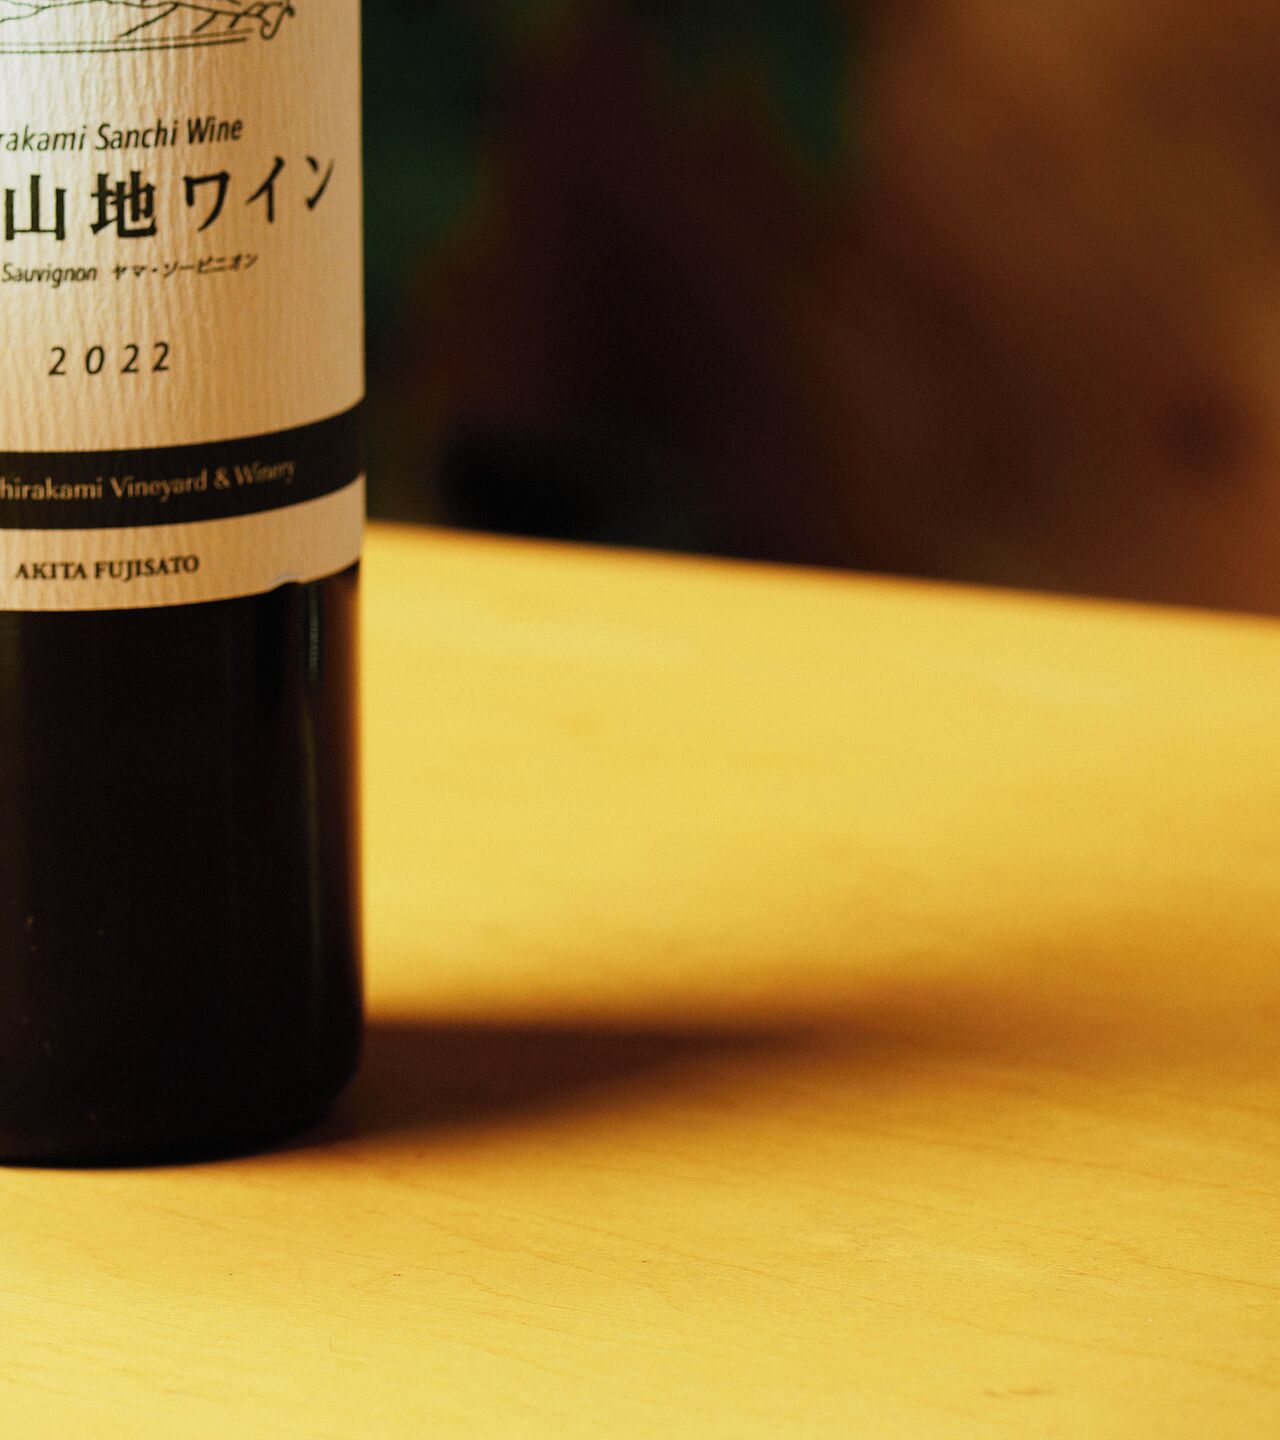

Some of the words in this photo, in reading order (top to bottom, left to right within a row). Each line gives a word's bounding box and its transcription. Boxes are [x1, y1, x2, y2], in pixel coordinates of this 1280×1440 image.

[95, 119, 178, 151] Sanchi
[187, 116, 244, 144] Wine
[1, 262, 97, 289] Sauvignon
[48, 342, 170, 376] 2022
[110, 467, 208, 503] Vineyard
[213, 466, 232, 490] &
[234, 461, 295, 485] Winery
[15, 562, 87, 580] AKITA
[94, 554, 200, 583] FUJISATO
